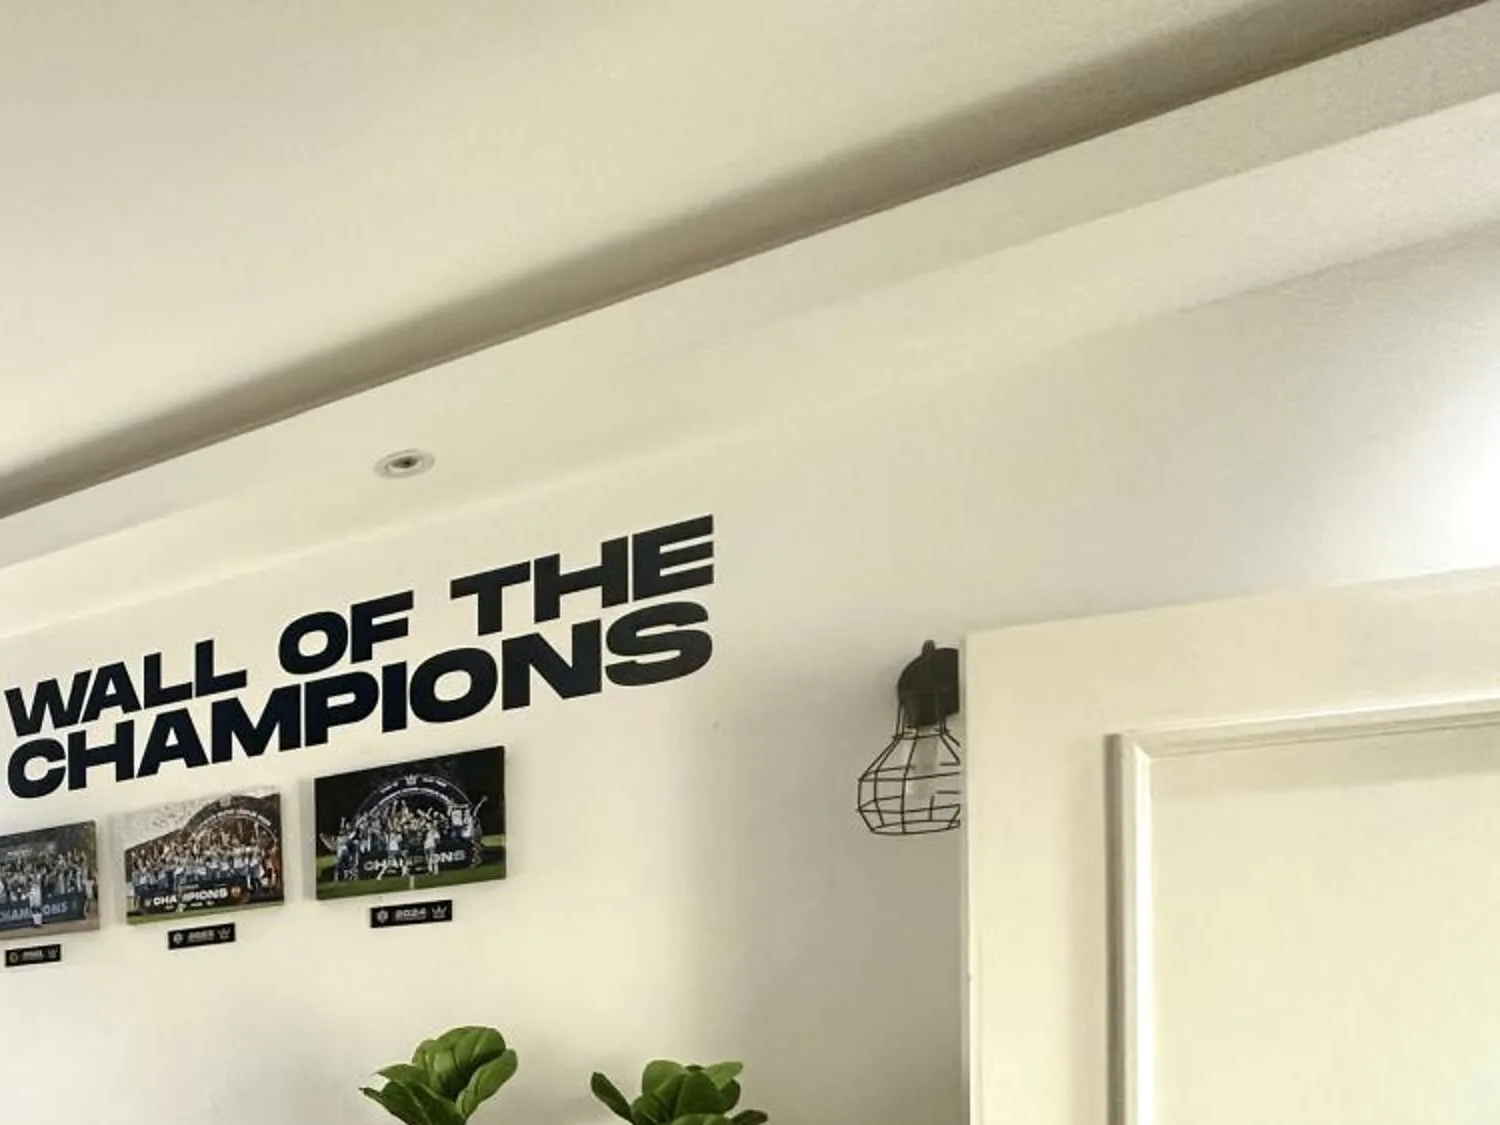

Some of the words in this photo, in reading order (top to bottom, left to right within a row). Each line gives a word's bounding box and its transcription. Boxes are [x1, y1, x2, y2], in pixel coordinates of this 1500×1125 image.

[4, 638, 247, 737] WALL
[278, 590, 414, 676] OF
[450, 514, 714, 636] THE
[6, 600, 714, 800] CHAMPIONS
